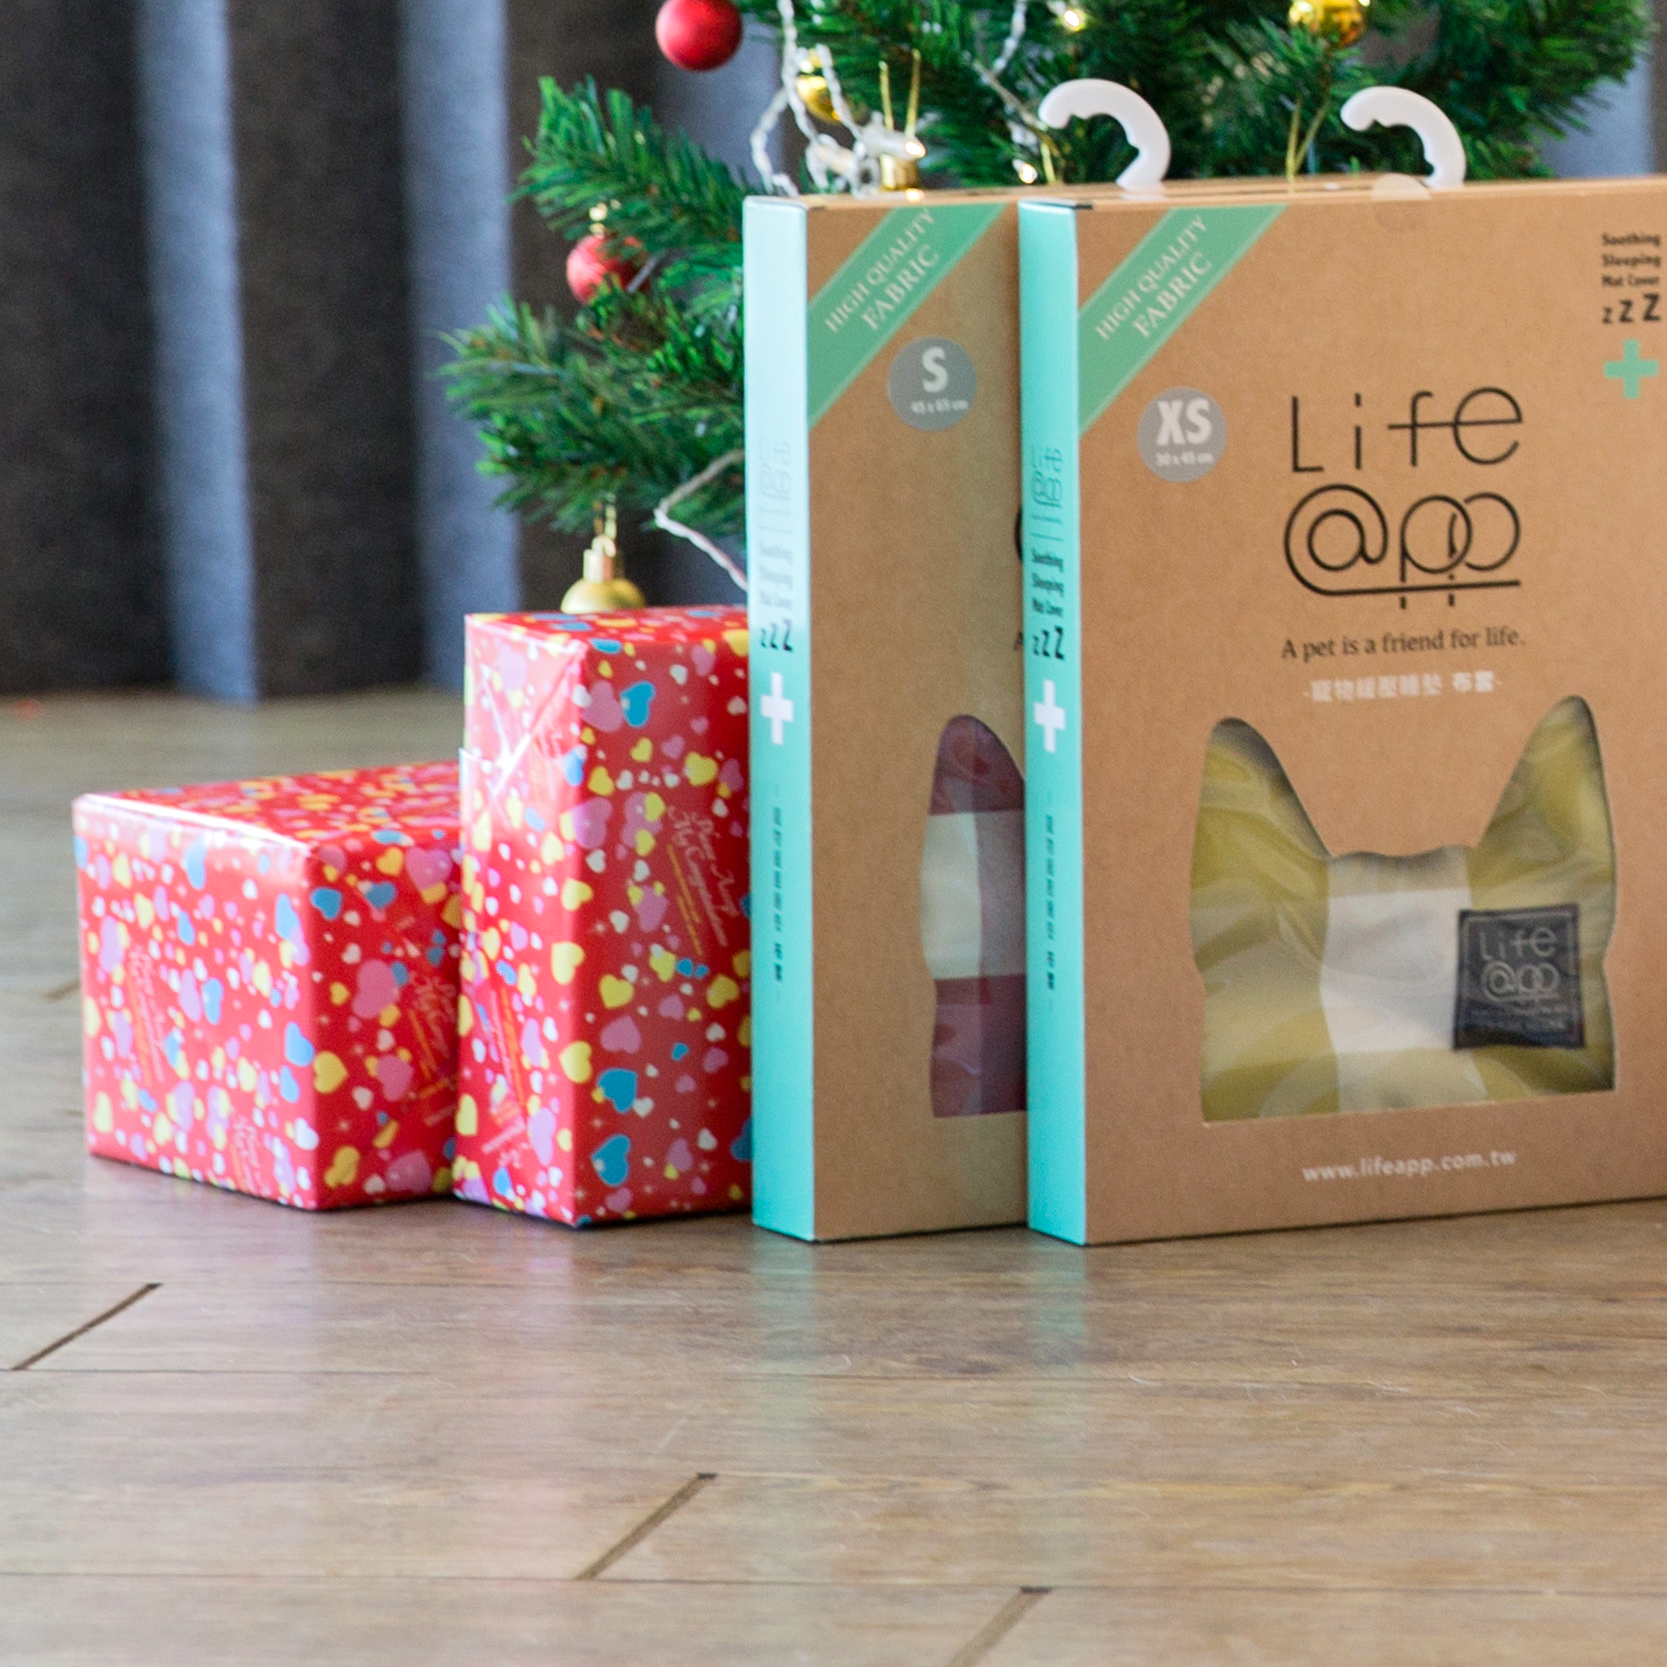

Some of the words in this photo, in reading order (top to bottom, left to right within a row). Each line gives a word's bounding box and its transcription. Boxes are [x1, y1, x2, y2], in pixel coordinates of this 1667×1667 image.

[1602, 232, 1661, 248] Soothing
[1602, 253, 1661, 269] Sleeping
[824, 281, 873, 333] HIGH
[866, 207, 935, 285] QUALITY
[861, 243, 940, 331] FABRIC
[1094, 289, 1141, 340] HIGH
[1137, 213, 1208, 293] QUALITY
[1131, 250, 1213, 339] FABRIC
[920, 346, 949, 394] S
[1155, 396, 1213, 447] XS
[1291, 386, 1523, 474] Life
[1281, 638, 1298, 660] A
[1302, 638, 1336, 663] pet
[1341, 635, 1360, 656] is
[1363, 637, 1378, 655] a
[1381, 630, 1445, 654] friend
[1449, 628, 1482, 650] for
[1485, 625, 1526, 647] life.
[1301, 1149, 1517, 1183] www.lifeapp.com.tw
